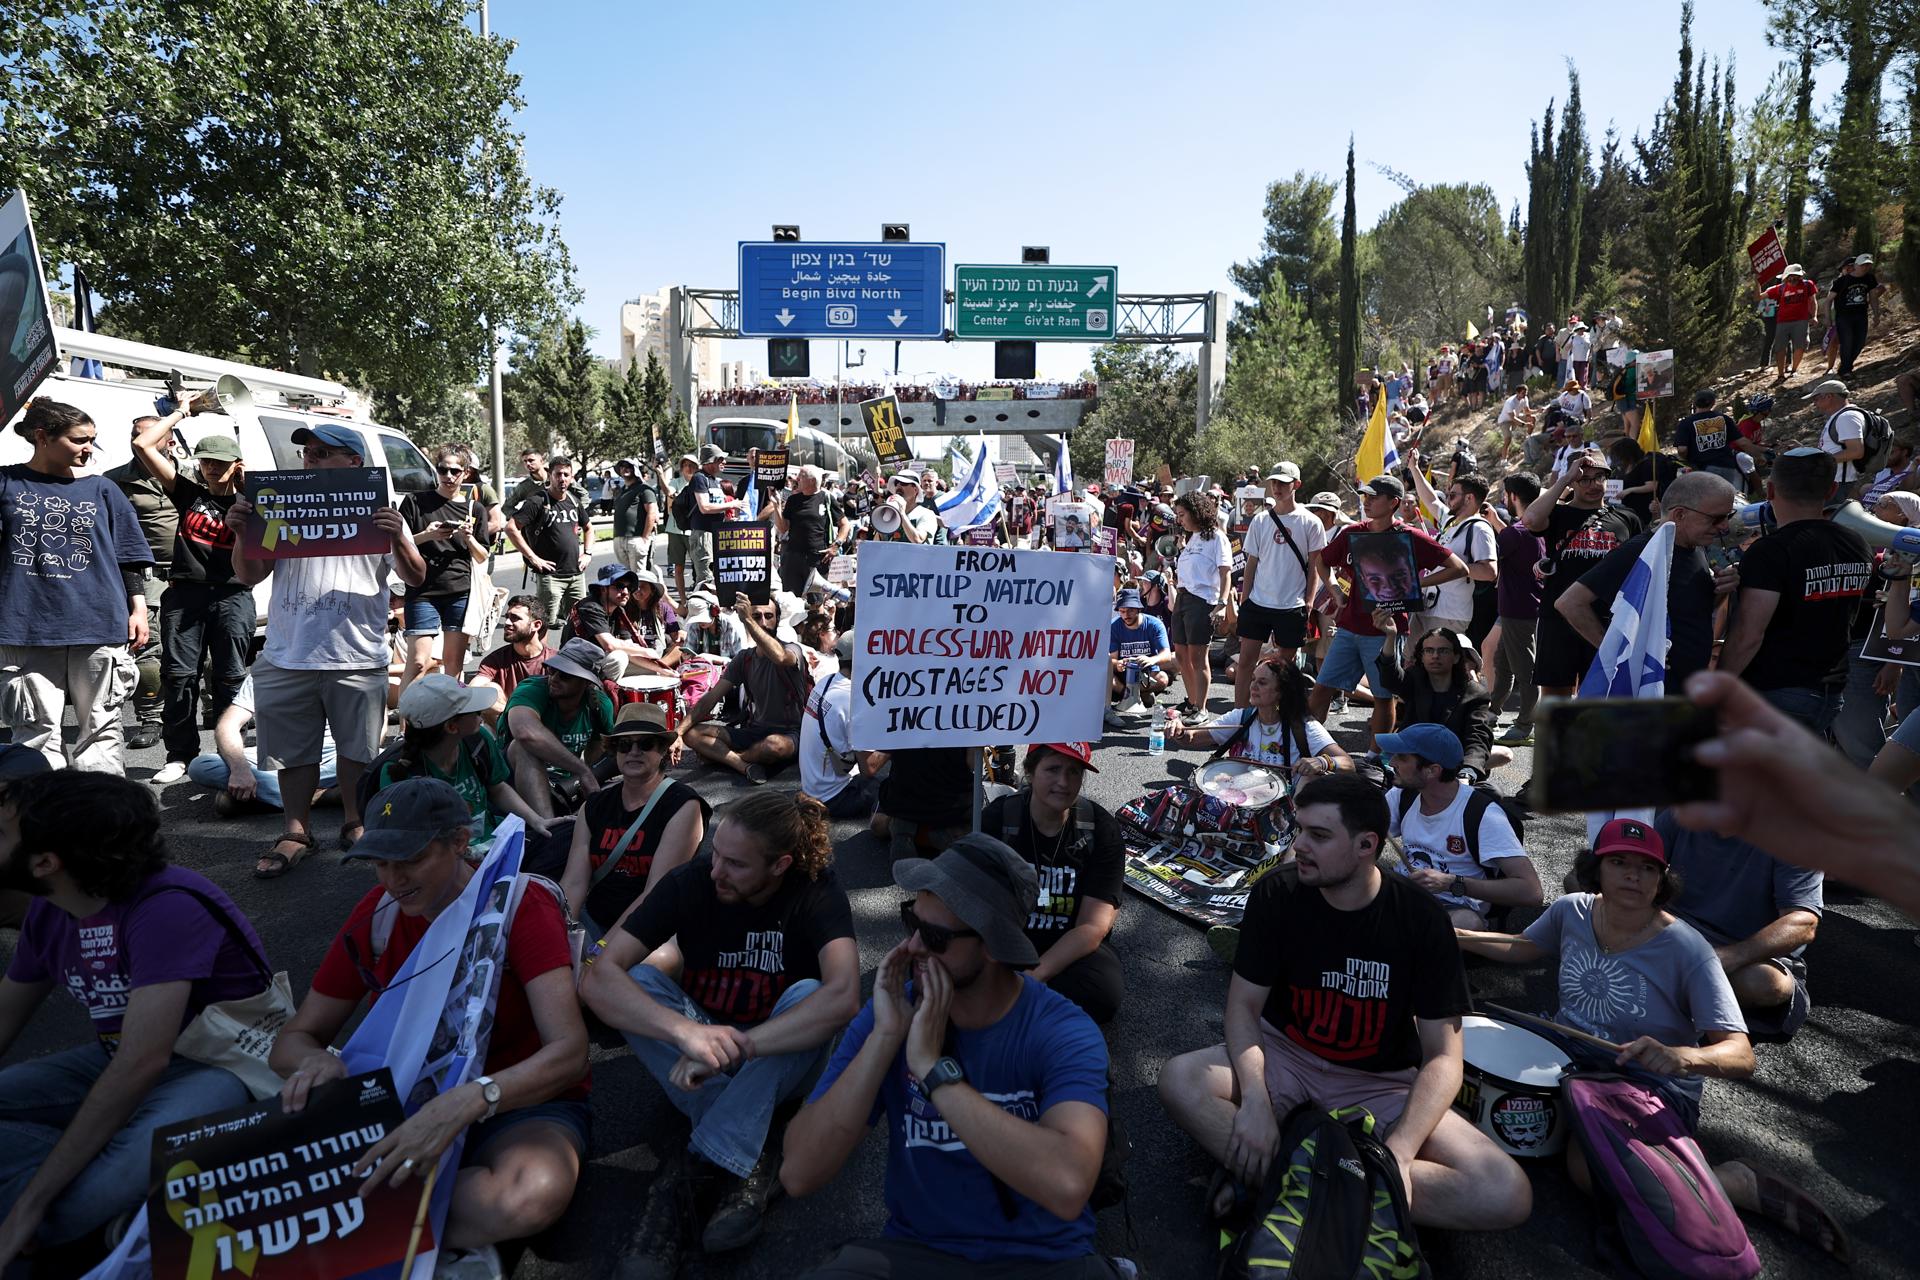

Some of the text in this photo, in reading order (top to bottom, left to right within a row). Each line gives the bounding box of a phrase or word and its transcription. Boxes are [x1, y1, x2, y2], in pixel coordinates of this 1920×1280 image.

[792, 253, 821, 269] צפון
[829, 253, 855, 269] בגין
[1756, 251, 1782, 272] WAR
[791, 271, 821, 284] شمال
[867, 272, 892, 284] جادة
[962, 279, 1078, 292] גבעת רם מרכז העיר
[783, 288, 900, 300] Begin Blvd North
[997, 298, 1018, 311] مركز
[1028, 299, 1042, 312] رام
[834, 311, 848, 321] 50
[974, 315, 1007, 325] Center
[1025, 316, 1079, 326] Giv'at Ram
[869, 401, 895, 431] לא
[1109, 440, 1131, 458] STOP
[258, 491, 376, 504] שחרור החטופים
[264, 506, 371, 519] וסיום המלחמה
[280, 523, 358, 540] עכשיו
[719, 529, 764, 539] מצילים את
[719, 539, 764, 550] החטופים
[719, 556, 765, 570] מסרבים
[955, 551, 1016, 573] FROM
[719, 569, 766, 583] למלחמה
[983, 579, 1074, 605] NATION
[953, 604, 988, 623] TO
[867, 629, 1100, 660] ENDLESS-WAR NATION
[862, 665, 1073, 706] (HOSTAGES NOT
[886, 700, 1039, 736] INCLUDED)
[1149, 879, 1179, 898] החטוף
[81, 937, 113, 949] למלחמה
[718, 951, 758, 968] הביתה
[1322, 972, 1388, 999] אותם הביתה
[1289, 984, 1388, 1049] עכשיו
[204, 1125, 216, 1137] על
[219, 1119, 247, 1133] תעמוד
[904, 1114, 959, 1147] תקן
[189, 1130, 202, 1142] דם
[167, 1123, 385, 1199] שחרור החטופים
[184, 1156, 383, 1230] יום המלחמה
[216, 1195, 365, 1272] עכשיו
